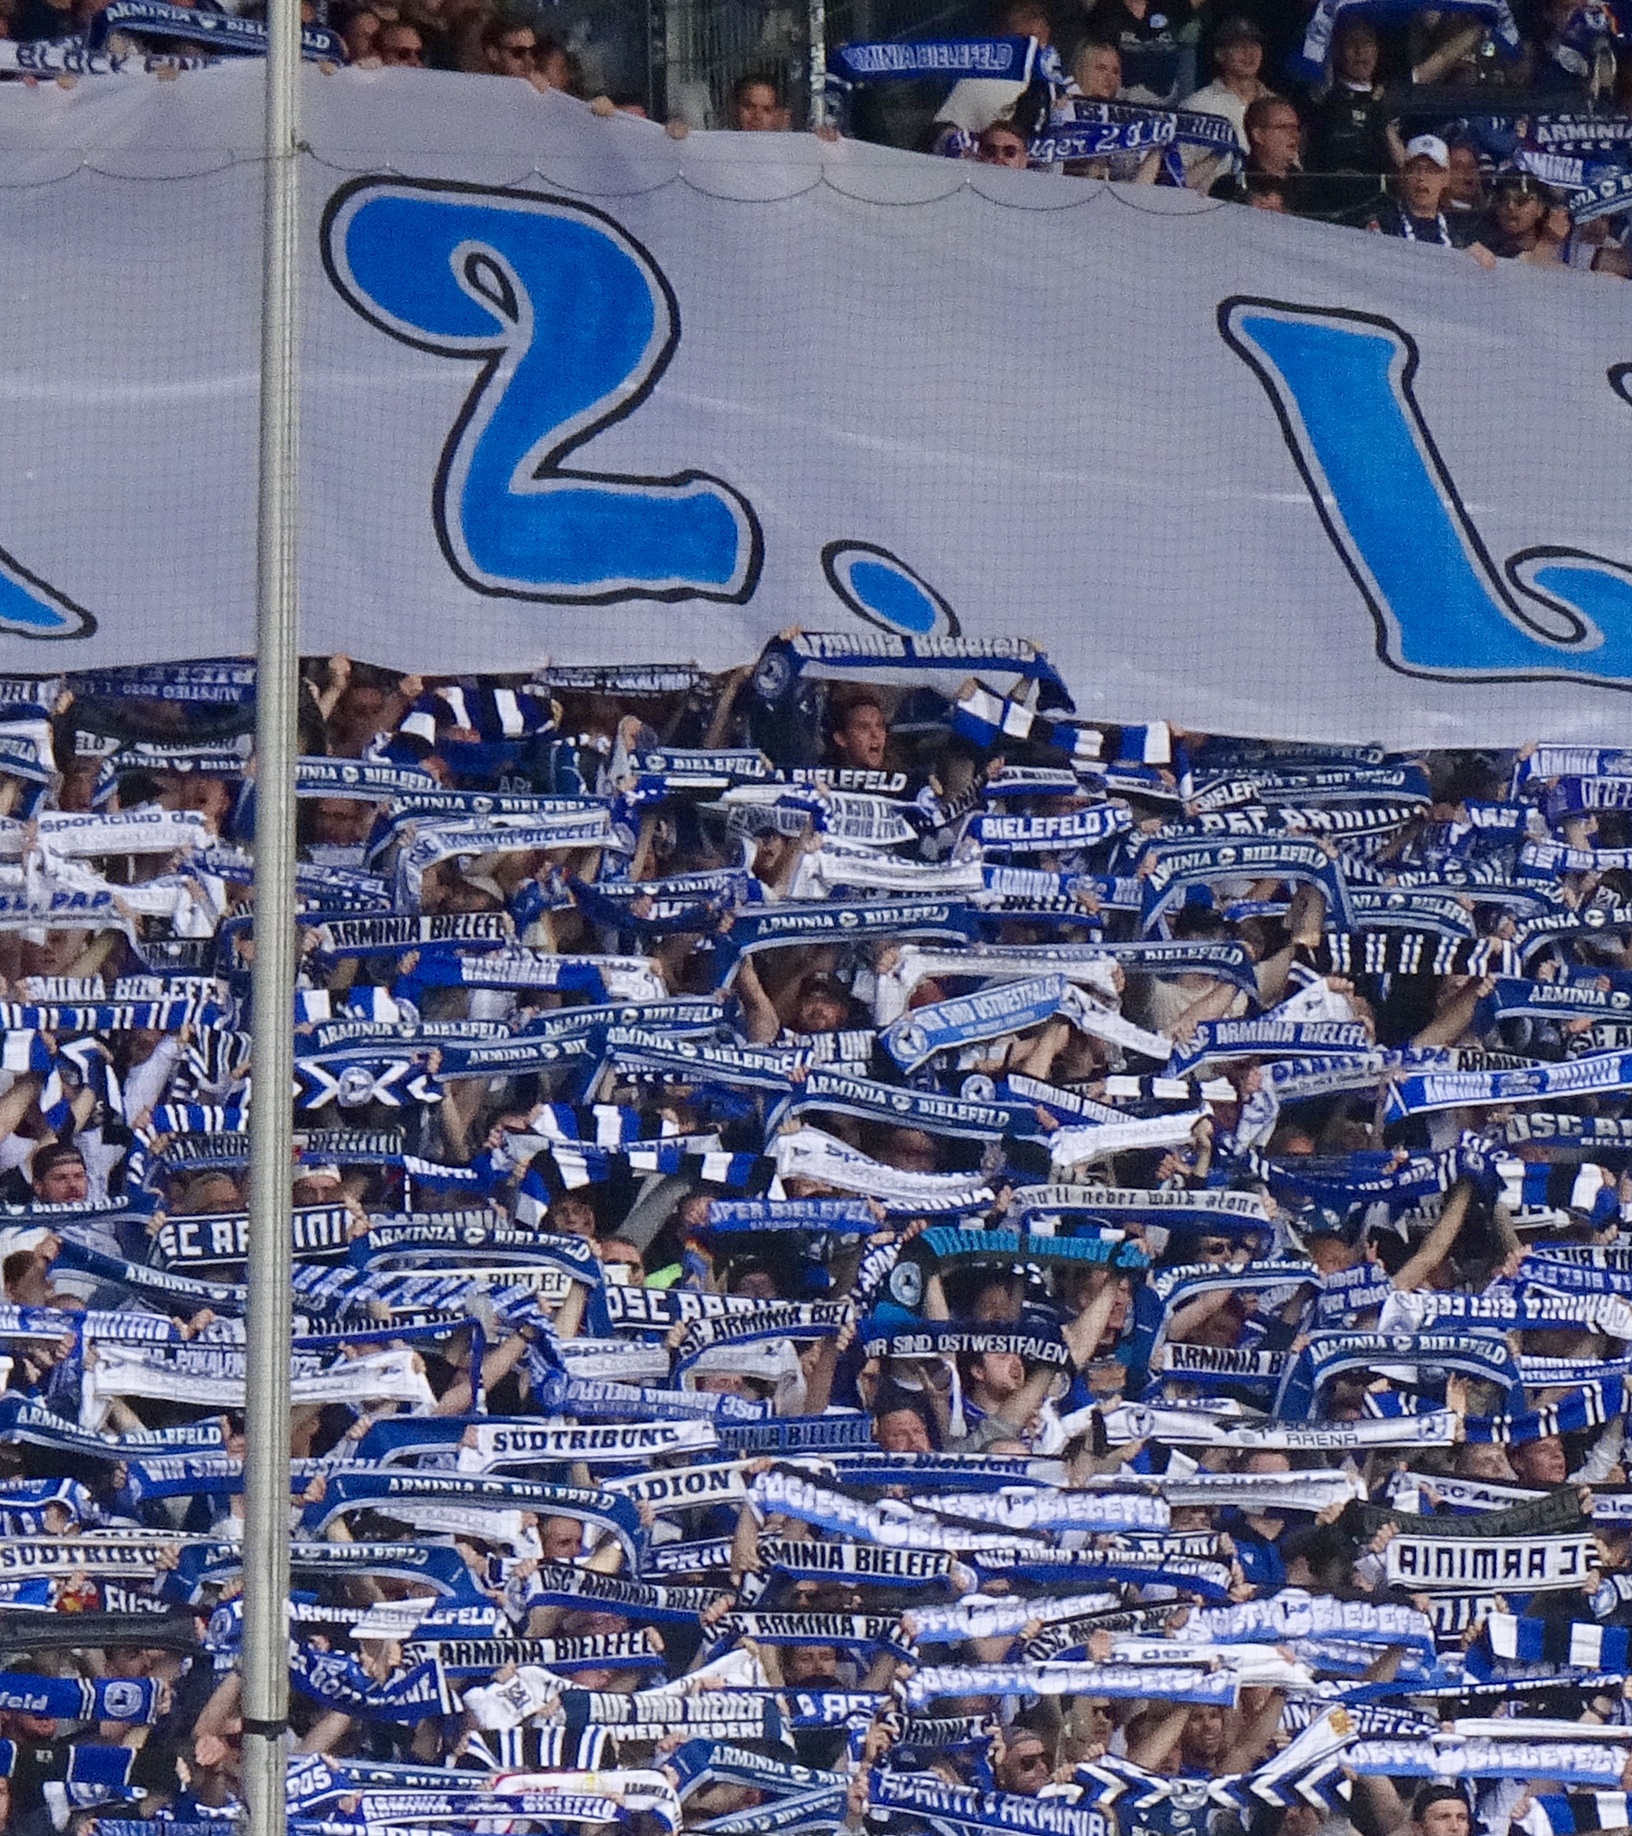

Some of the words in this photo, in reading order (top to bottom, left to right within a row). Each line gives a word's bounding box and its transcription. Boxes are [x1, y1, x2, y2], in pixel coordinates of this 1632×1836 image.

[322, 178, 958, 642] 2.
[791, 768, 908, 792] BIELEFELD
[1241, 845, 1328, 869] BIELEFELD
[327, 916, 421, 948] ARMINIA
[756, 911, 830, 937] ARMINIA
[1529, 984, 1610, 1007] ARMINIA
[607, 1027, 675, 1051] ARMINIA
[1216, 1022, 1296, 1047] ARMINIA
[805, 1075, 887, 1104] ARMINIA
[367, 1228, 460, 1247] ARMINIA
[494, 1229, 591, 1262] BIELEFELD
[712, 1308, 802, 1343] ARMINIA
[892, 1332, 935, 1352] SIND
[1309, 1333, 1390, 1363] ARMINIA
[1420, 1334, 1508, 1365] BIELEFELD
[1171, 1344, 1261, 1373] ARMINIA
[125, 1424, 222, 1445] BIELEFELD
[1285, 1432, 1358, 1447] ARENA
[579, 1576, 659, 1601] ARMINIA
[757, 1613, 856, 1637] ARMINIA
[439, 1639, 545, 1666] ARMINIA
[634, 1696, 681, 1722] UND
[711, 1746, 788, 1779] ARMINIA
